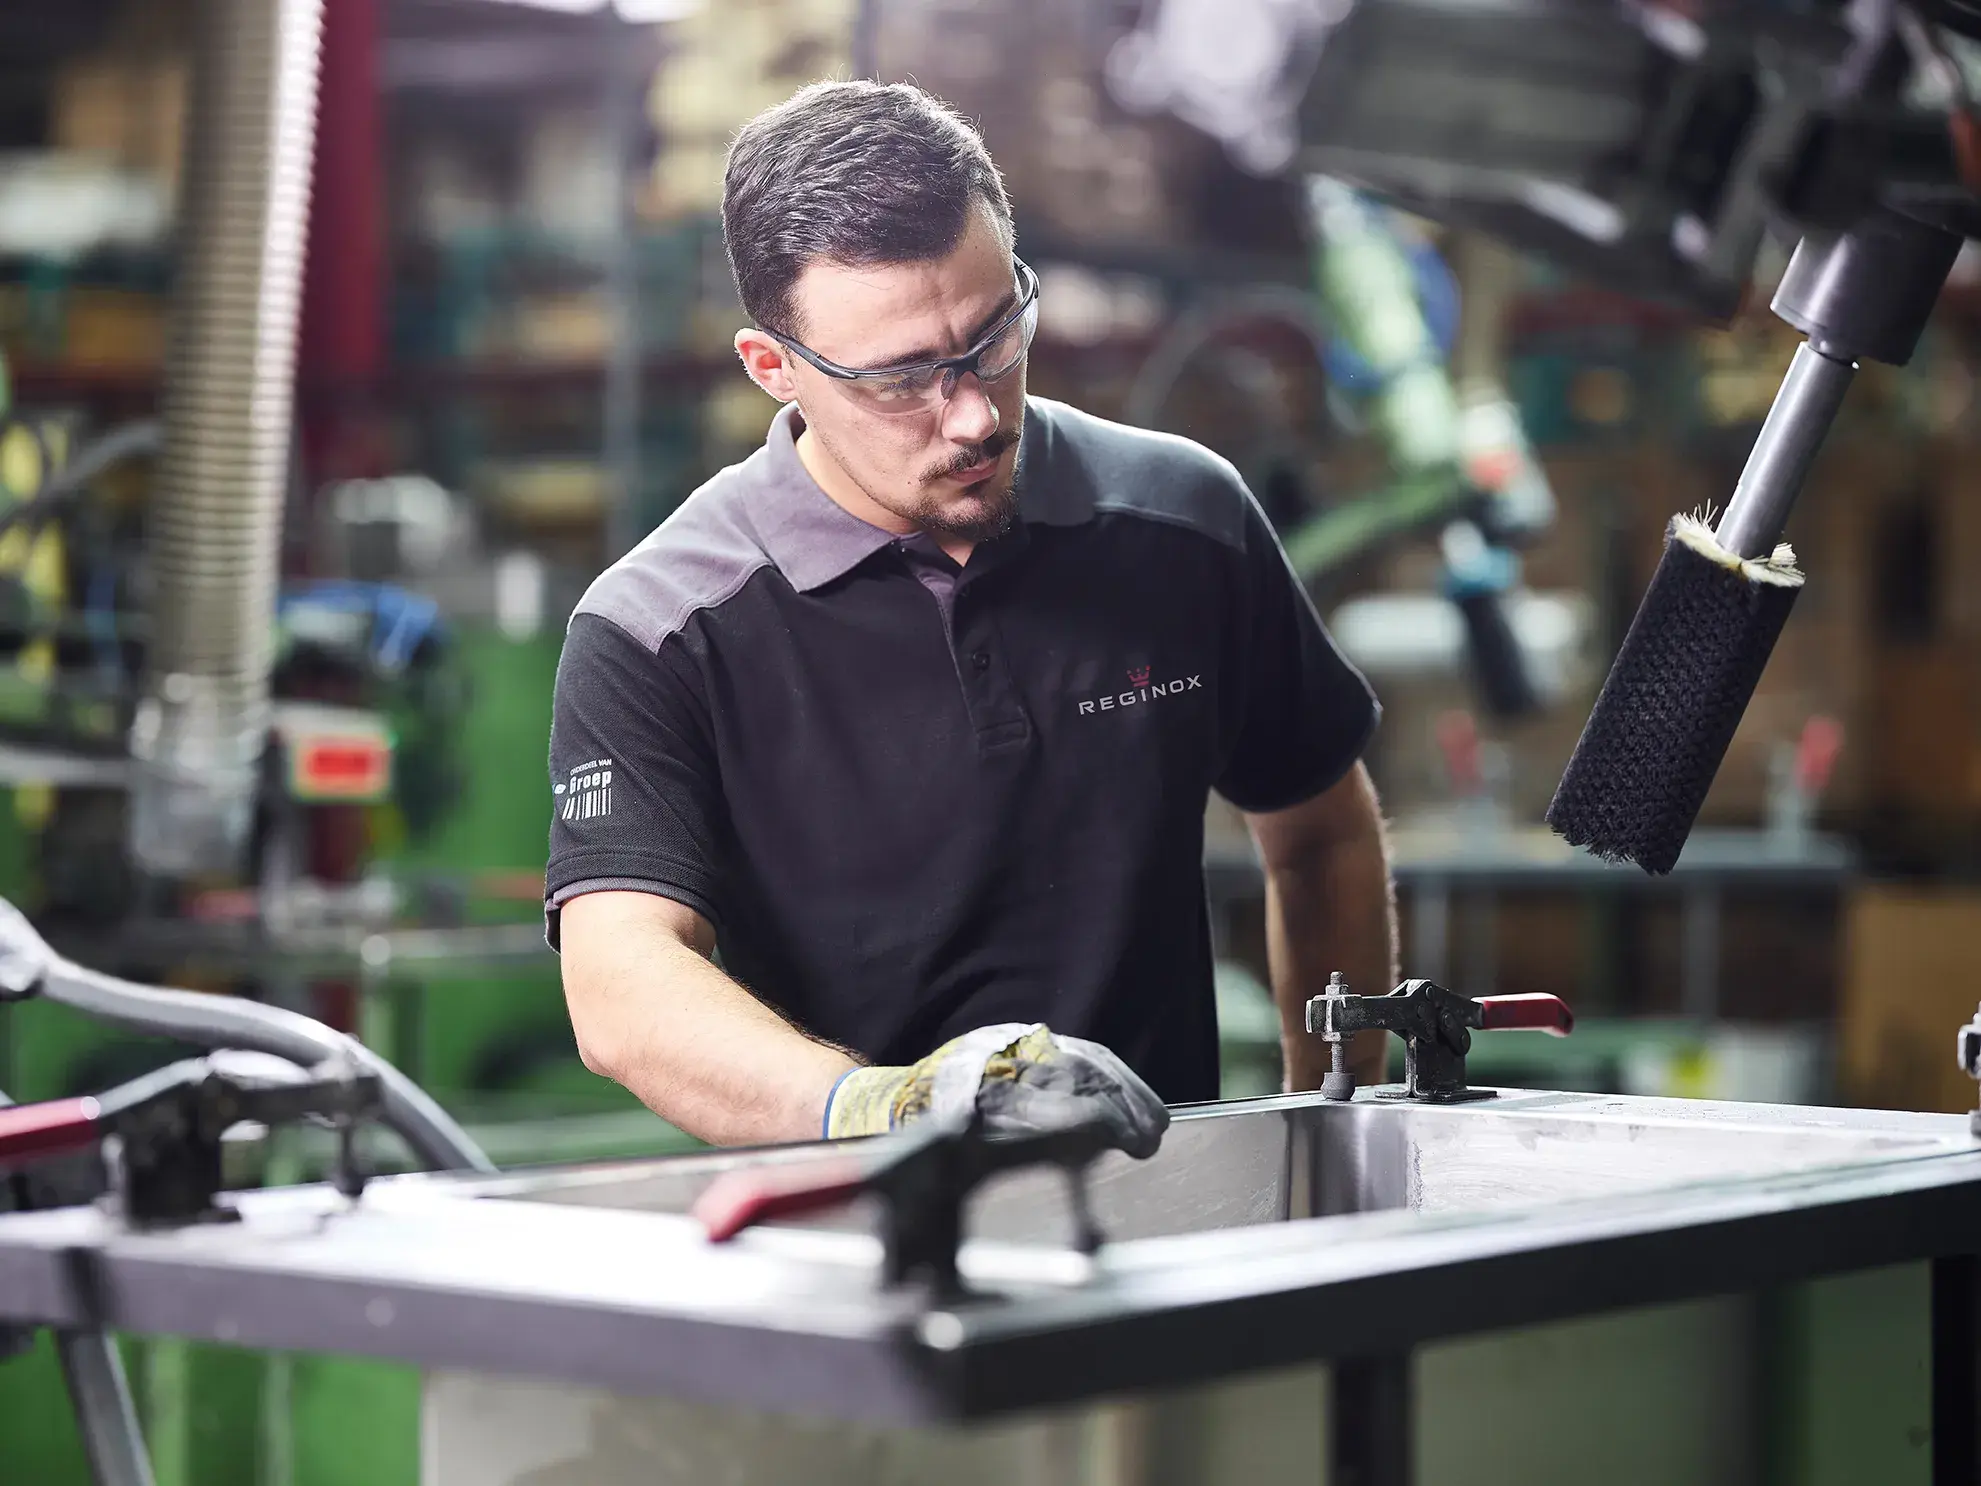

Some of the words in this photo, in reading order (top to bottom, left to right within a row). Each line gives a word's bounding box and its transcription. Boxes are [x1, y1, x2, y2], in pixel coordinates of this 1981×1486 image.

[1078, 674, 1202, 715] REGINOX
[598, 758, 612, 767] VAN
[570, 771, 612, 794] Groep
